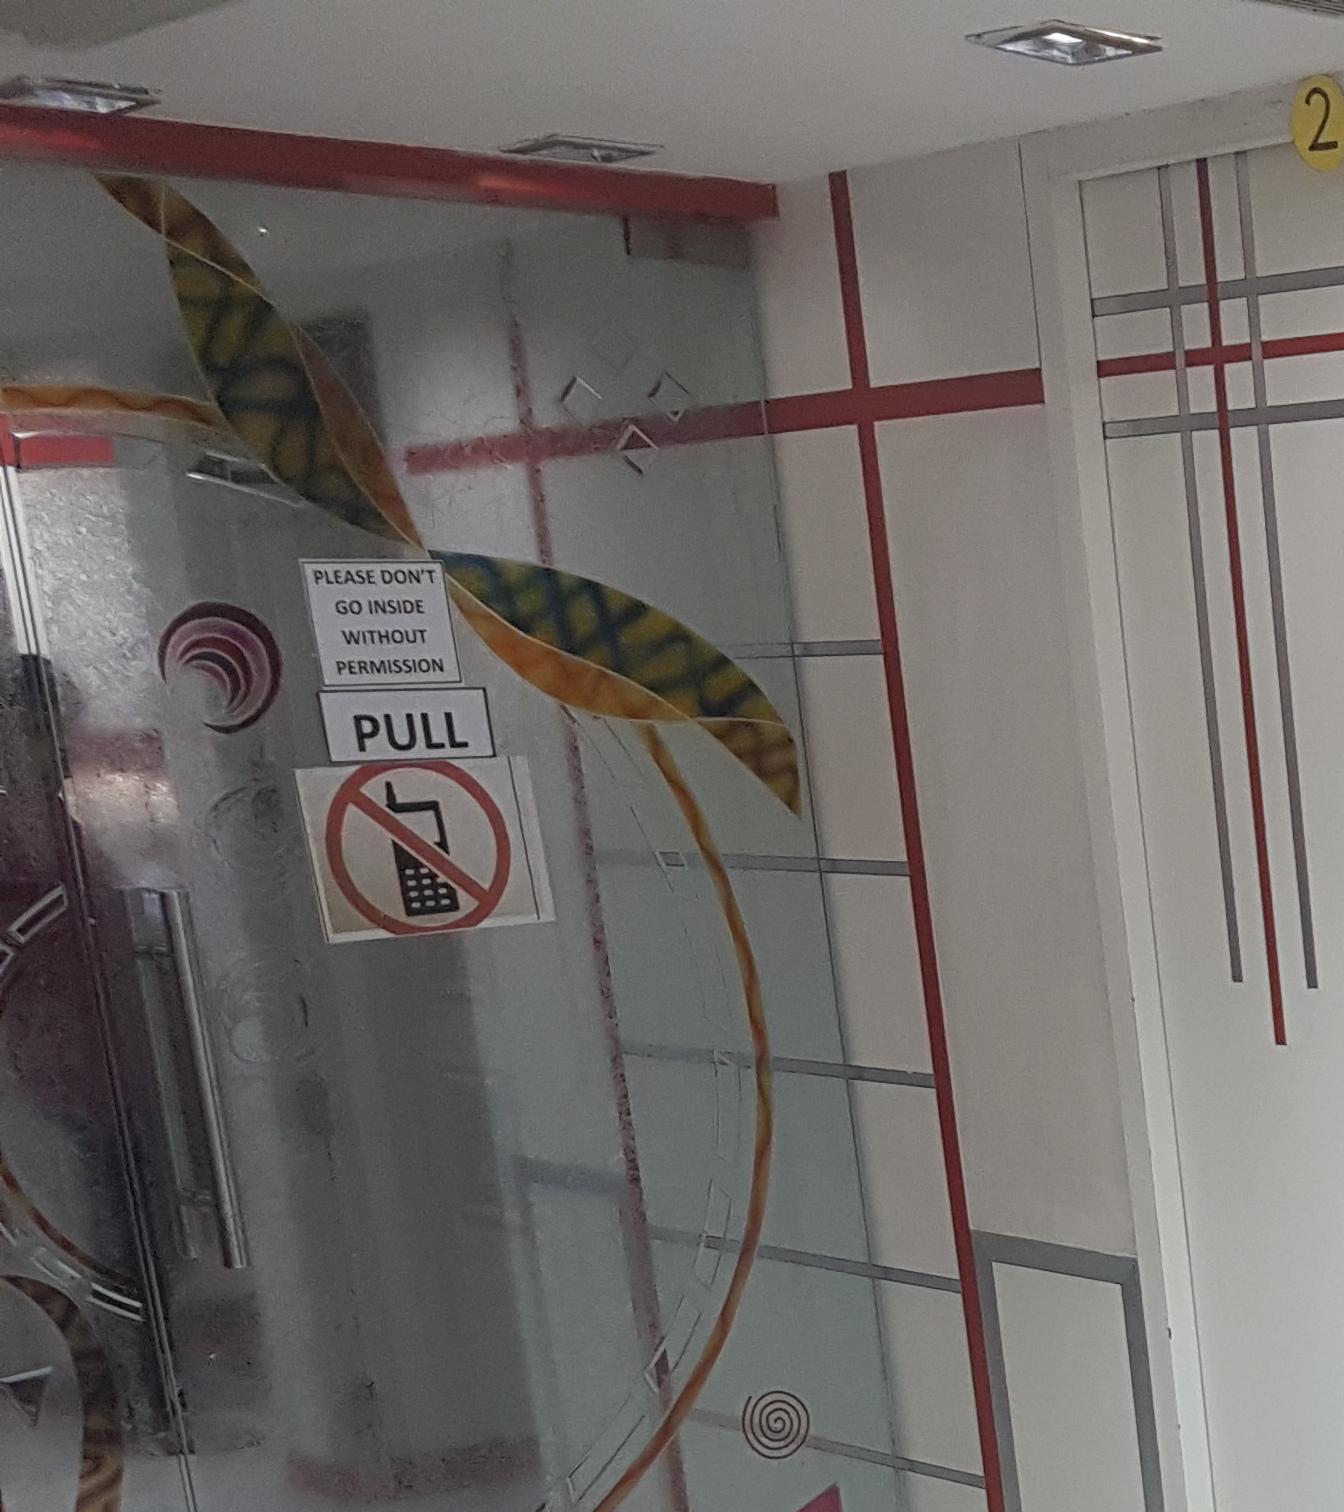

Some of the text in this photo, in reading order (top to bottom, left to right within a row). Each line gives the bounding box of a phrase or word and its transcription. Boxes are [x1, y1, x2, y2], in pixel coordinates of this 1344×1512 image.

[1305, 87, 1338, 151] 2
[313, 568, 436, 586] PLEASE DON'T
[335, 599, 425, 615] GO INSIDE
[343, 629, 427, 646] WITHOUT
[336, 658, 445, 675] PERMISSION
[353, 712, 469, 752] PULL
